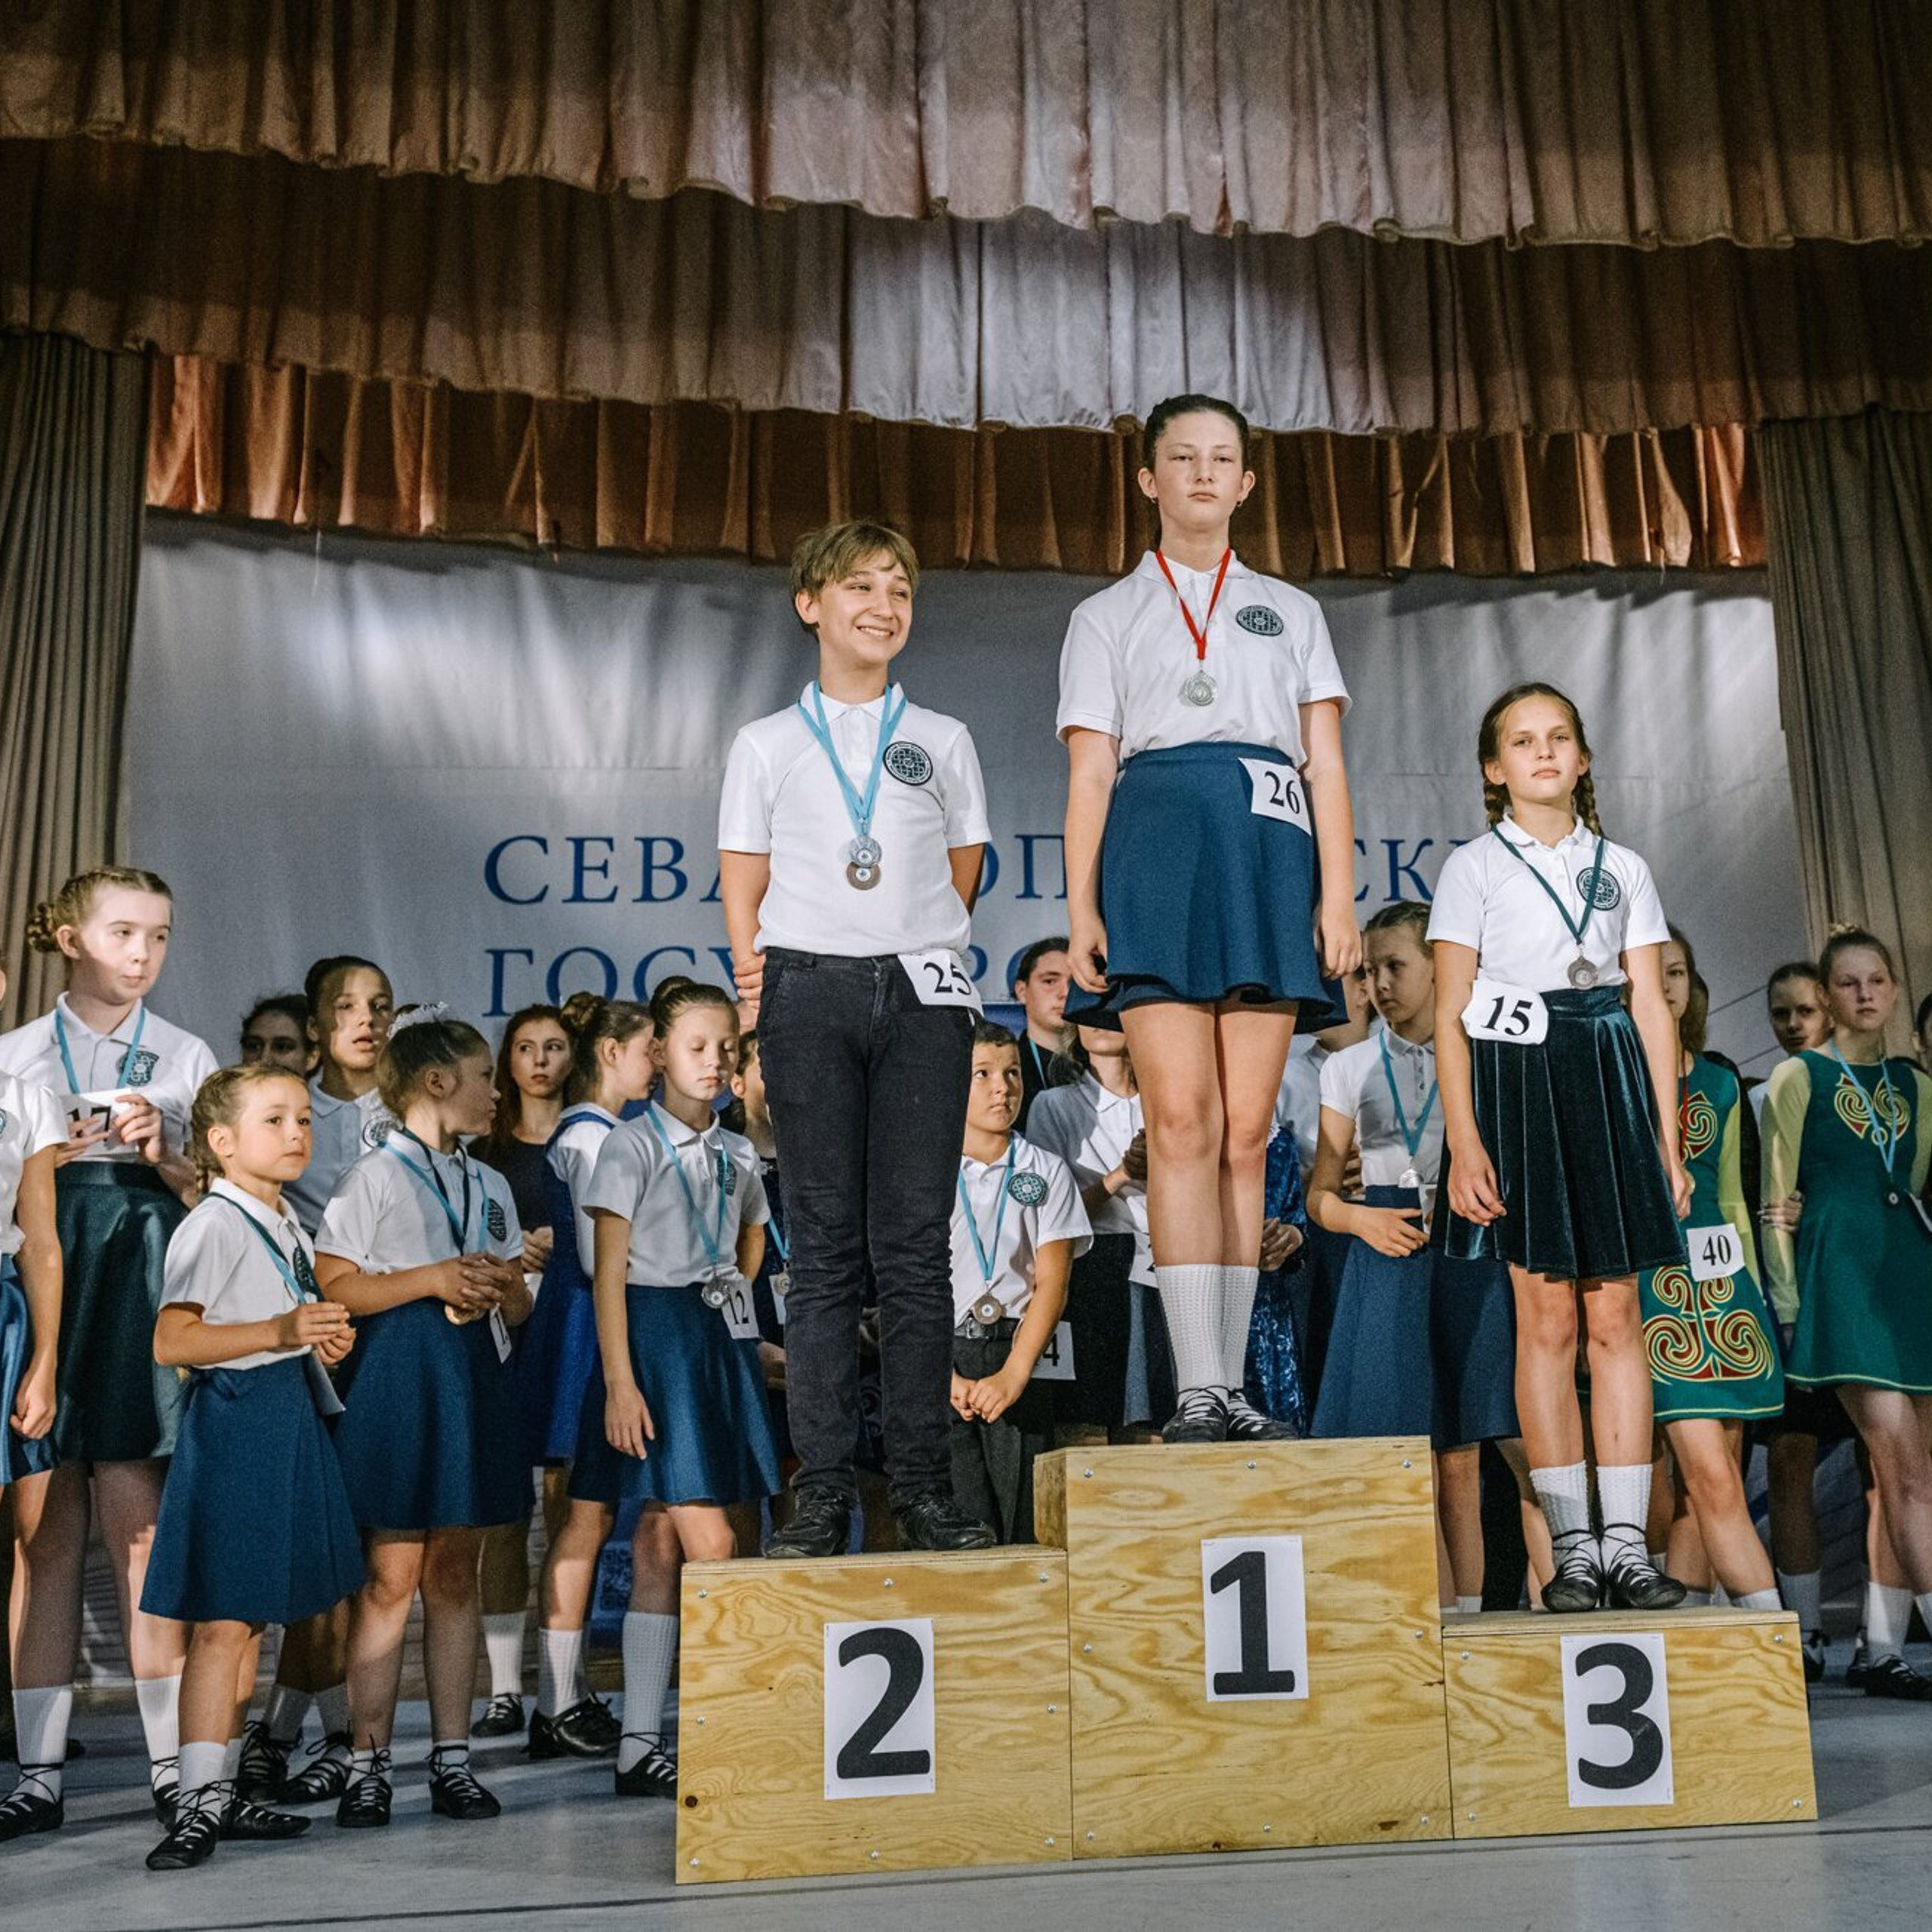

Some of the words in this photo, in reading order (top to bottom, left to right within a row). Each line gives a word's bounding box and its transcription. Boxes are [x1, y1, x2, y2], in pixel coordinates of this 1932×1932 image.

[1264, 771, 1300, 814] 26
[923, 961, 971, 995] 25
[1480, 995, 1533, 1036] 15
[1703, 1234, 1731, 1266] 40
[1211, 1551, 1295, 1695] 1
[836, 1627, 931, 1780] 2
[1575, 1642, 1663, 1789] 3
